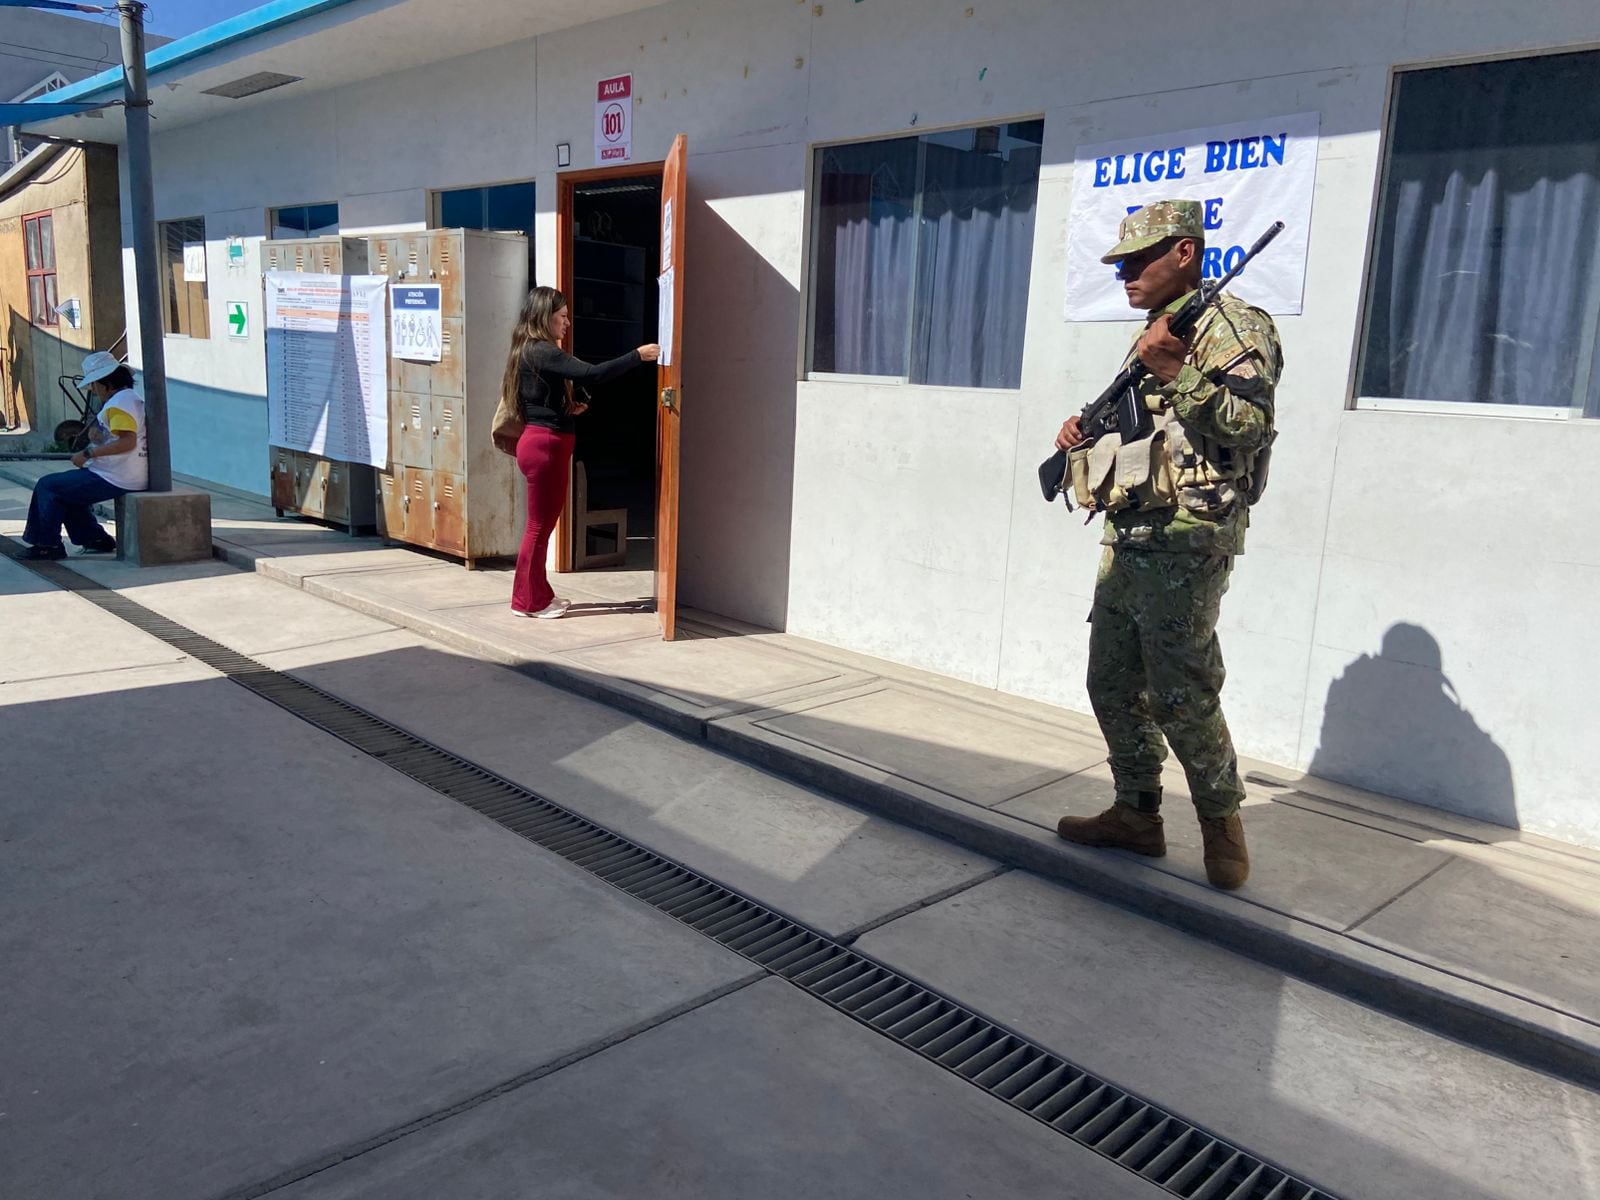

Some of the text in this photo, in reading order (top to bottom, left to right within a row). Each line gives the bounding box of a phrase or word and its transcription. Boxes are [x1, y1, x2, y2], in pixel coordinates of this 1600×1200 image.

[604, 82, 625, 96] AULA
[604, 112, 622, 135] 101
[1093, 132, 1288, 188] ELIGE BIEN
